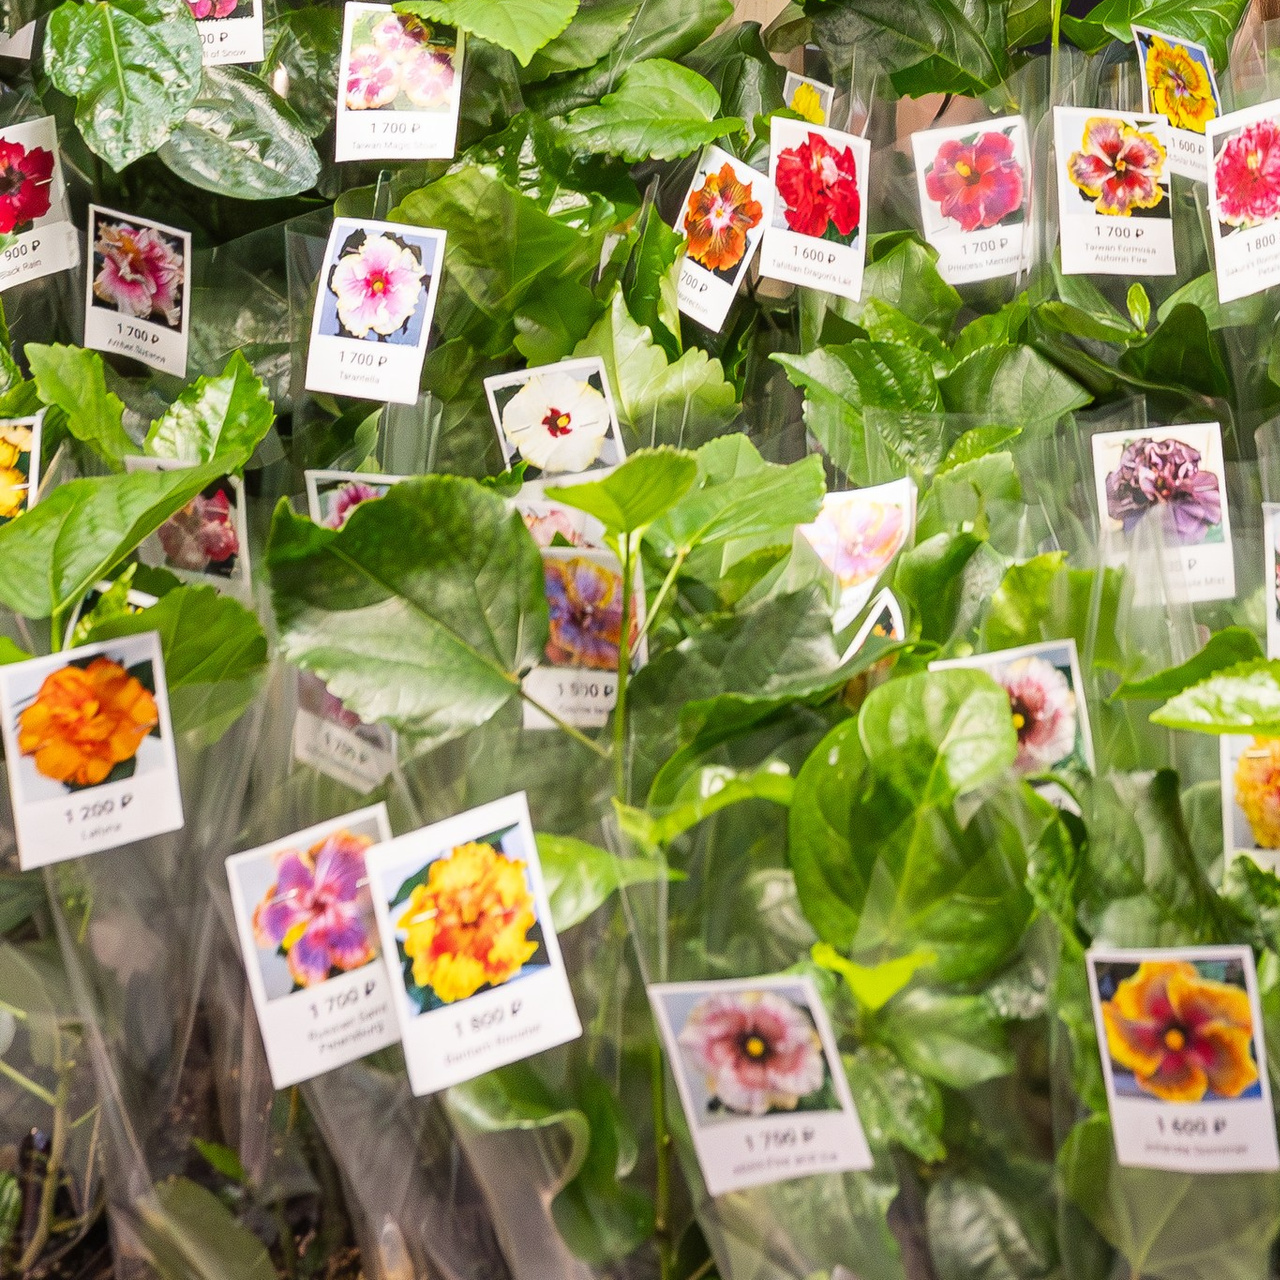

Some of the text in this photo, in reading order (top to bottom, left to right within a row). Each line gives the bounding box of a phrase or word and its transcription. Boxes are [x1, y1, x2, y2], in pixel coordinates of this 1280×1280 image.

[382, 122, 407, 134] 700
[1178, 139, 1196, 154] 600
[1107, 226, 1131, 238] 700
[972, 239, 996, 254] 700
[1254, 233, 1276, 250] 800
[4, 243, 28, 262] 900
[802, 248, 825, 263] 600
[22, 259, 42, 272] Rain
[947, 261, 983, 274] Princess
[680, 269, 699, 290] 700
[126, 325, 148, 342] 700
[350, 351, 374, 367] 700
